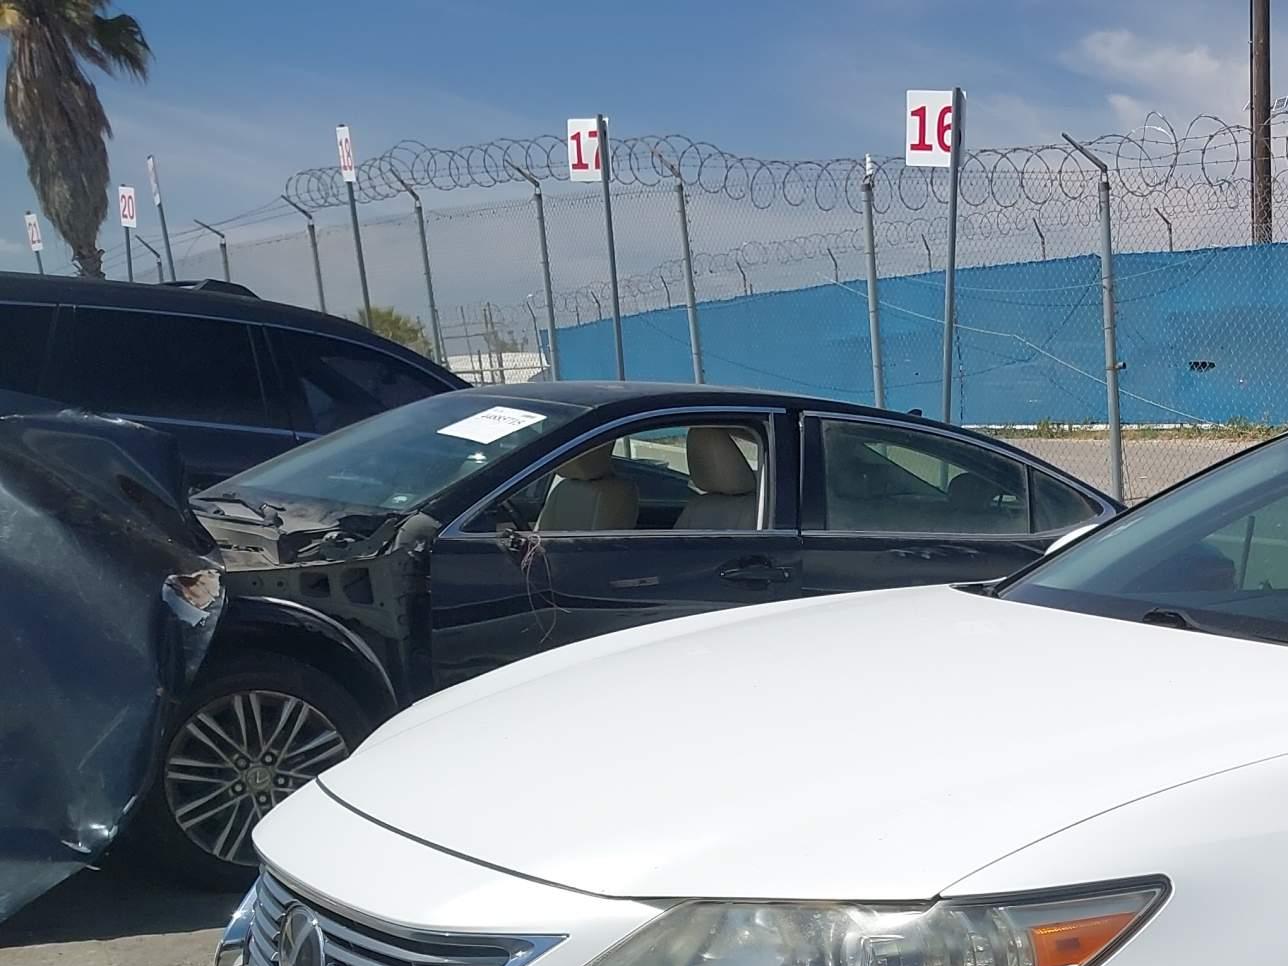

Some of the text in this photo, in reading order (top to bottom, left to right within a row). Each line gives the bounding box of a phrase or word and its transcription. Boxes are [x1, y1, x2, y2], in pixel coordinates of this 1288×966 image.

[910, 105, 953, 153] 16
[339, 138, 353, 171] 18
[120, 194, 135, 220] 20
